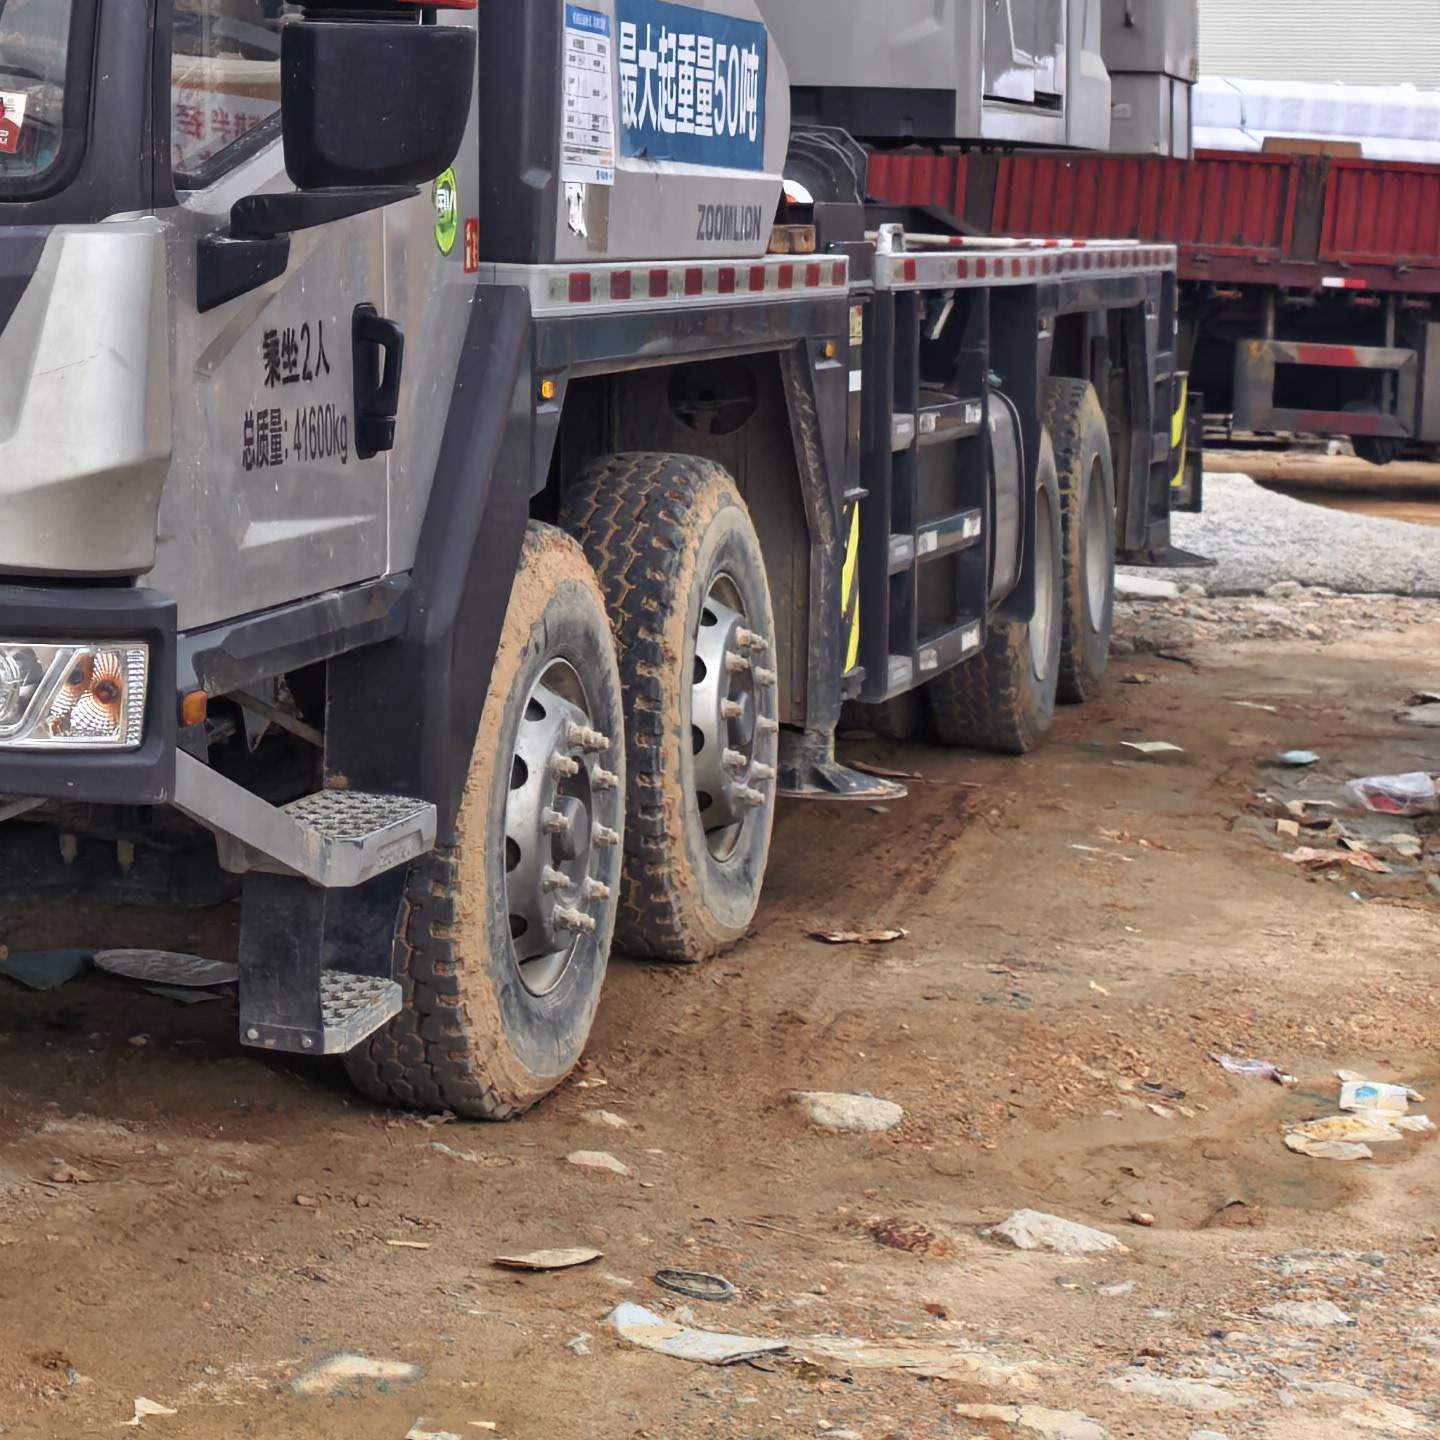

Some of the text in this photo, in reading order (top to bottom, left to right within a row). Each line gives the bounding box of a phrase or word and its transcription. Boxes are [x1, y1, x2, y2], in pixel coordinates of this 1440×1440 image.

[620, 21, 760, 143] 最大起重量50吨
[696, 204, 762, 241] ZOOMLION
[262, 320, 330, 388] 乘坐2人
